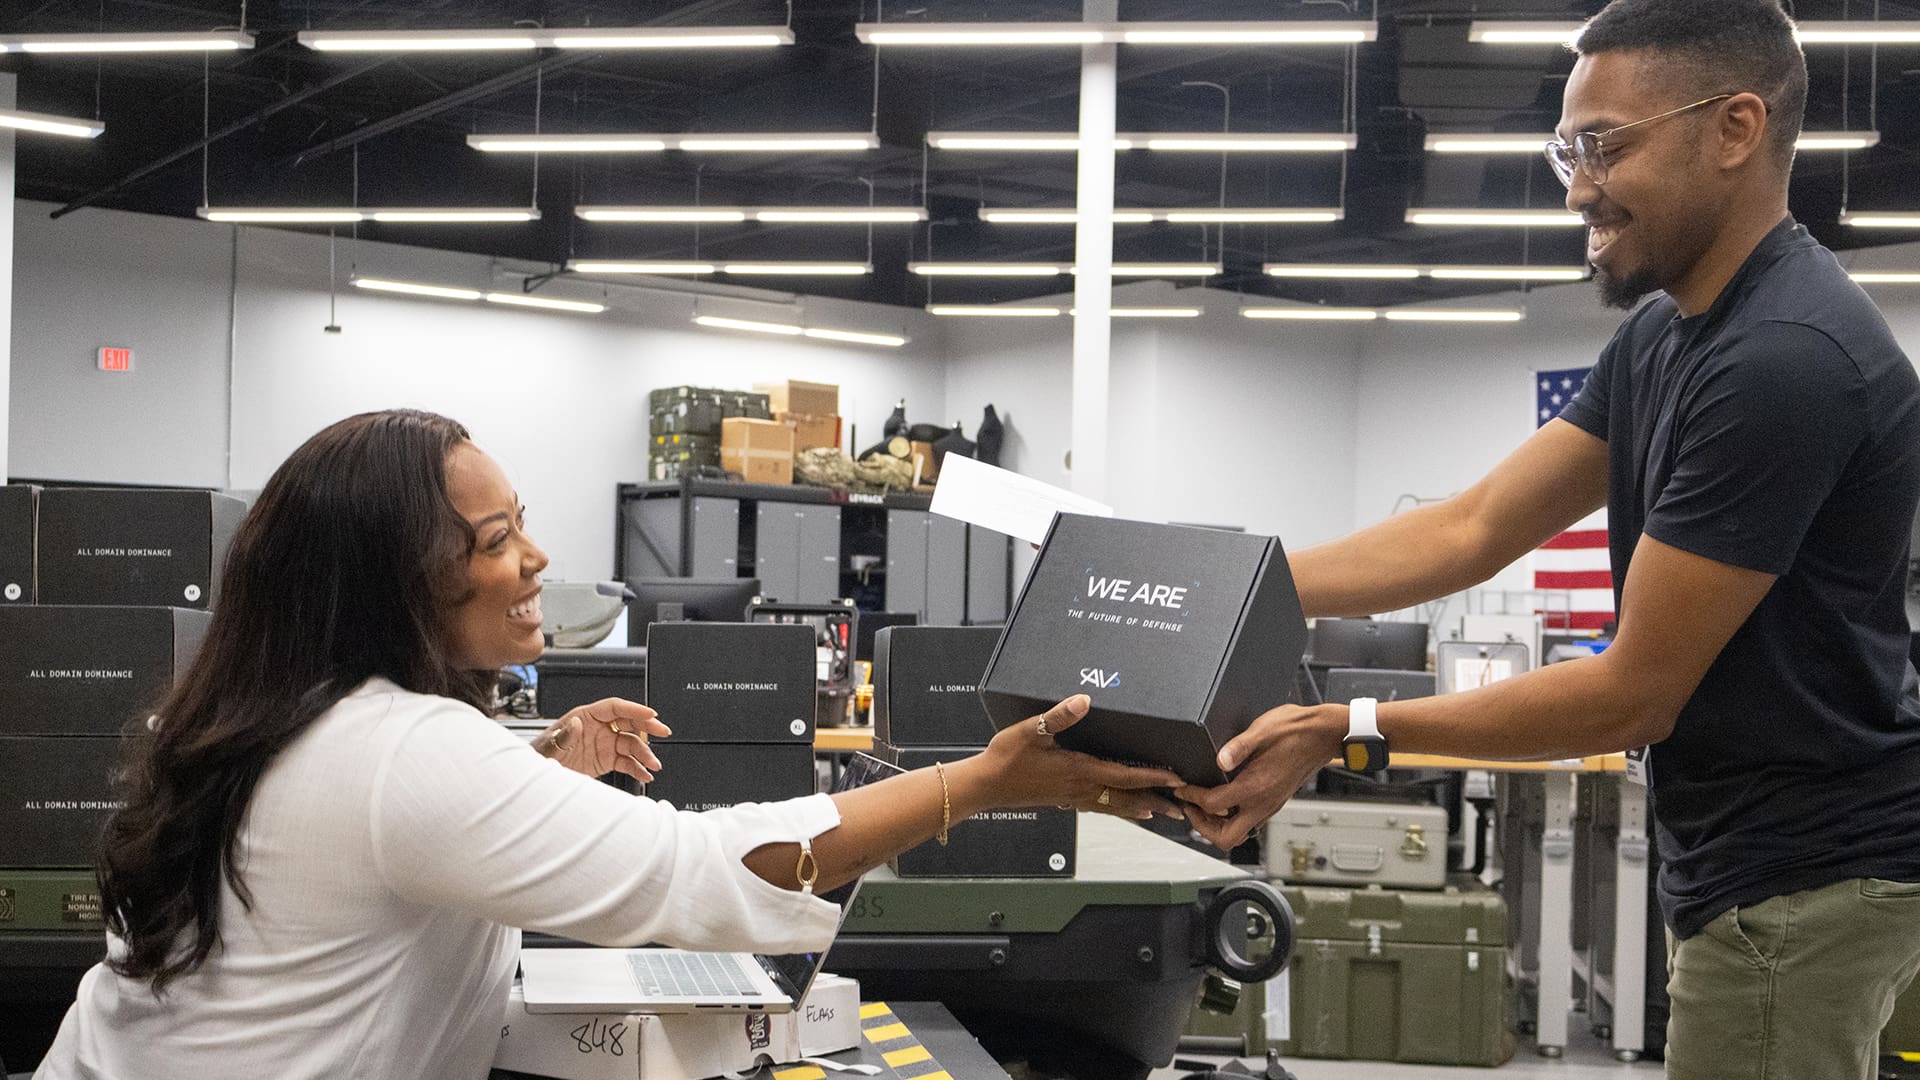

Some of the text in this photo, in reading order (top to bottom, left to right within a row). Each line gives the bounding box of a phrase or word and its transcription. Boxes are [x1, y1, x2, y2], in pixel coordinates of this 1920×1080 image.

[103, 347, 131, 371] EXIT
[77, 548, 172, 557] ALL DOMAIN DOMINANCE
[1087, 575, 1188, 609] WE ARE
[1067, 608, 1183, 632] THE FUTURE OF DEFENSE
[30, 669, 133, 679] ALL DOMAIN DOMINANCE
[686, 682, 778, 691] ALL DOMAIN DOMINANCE
[929, 684, 976, 692] ALL DOMAIN
[25, 800, 41, 808] ALL
[45, 800, 78, 809] DOMAIN
[992, 812, 1037, 820] DOMINANCE
[806, 1004, 834, 1022] FLAGS
[570, 1017, 628, 1056] 848
